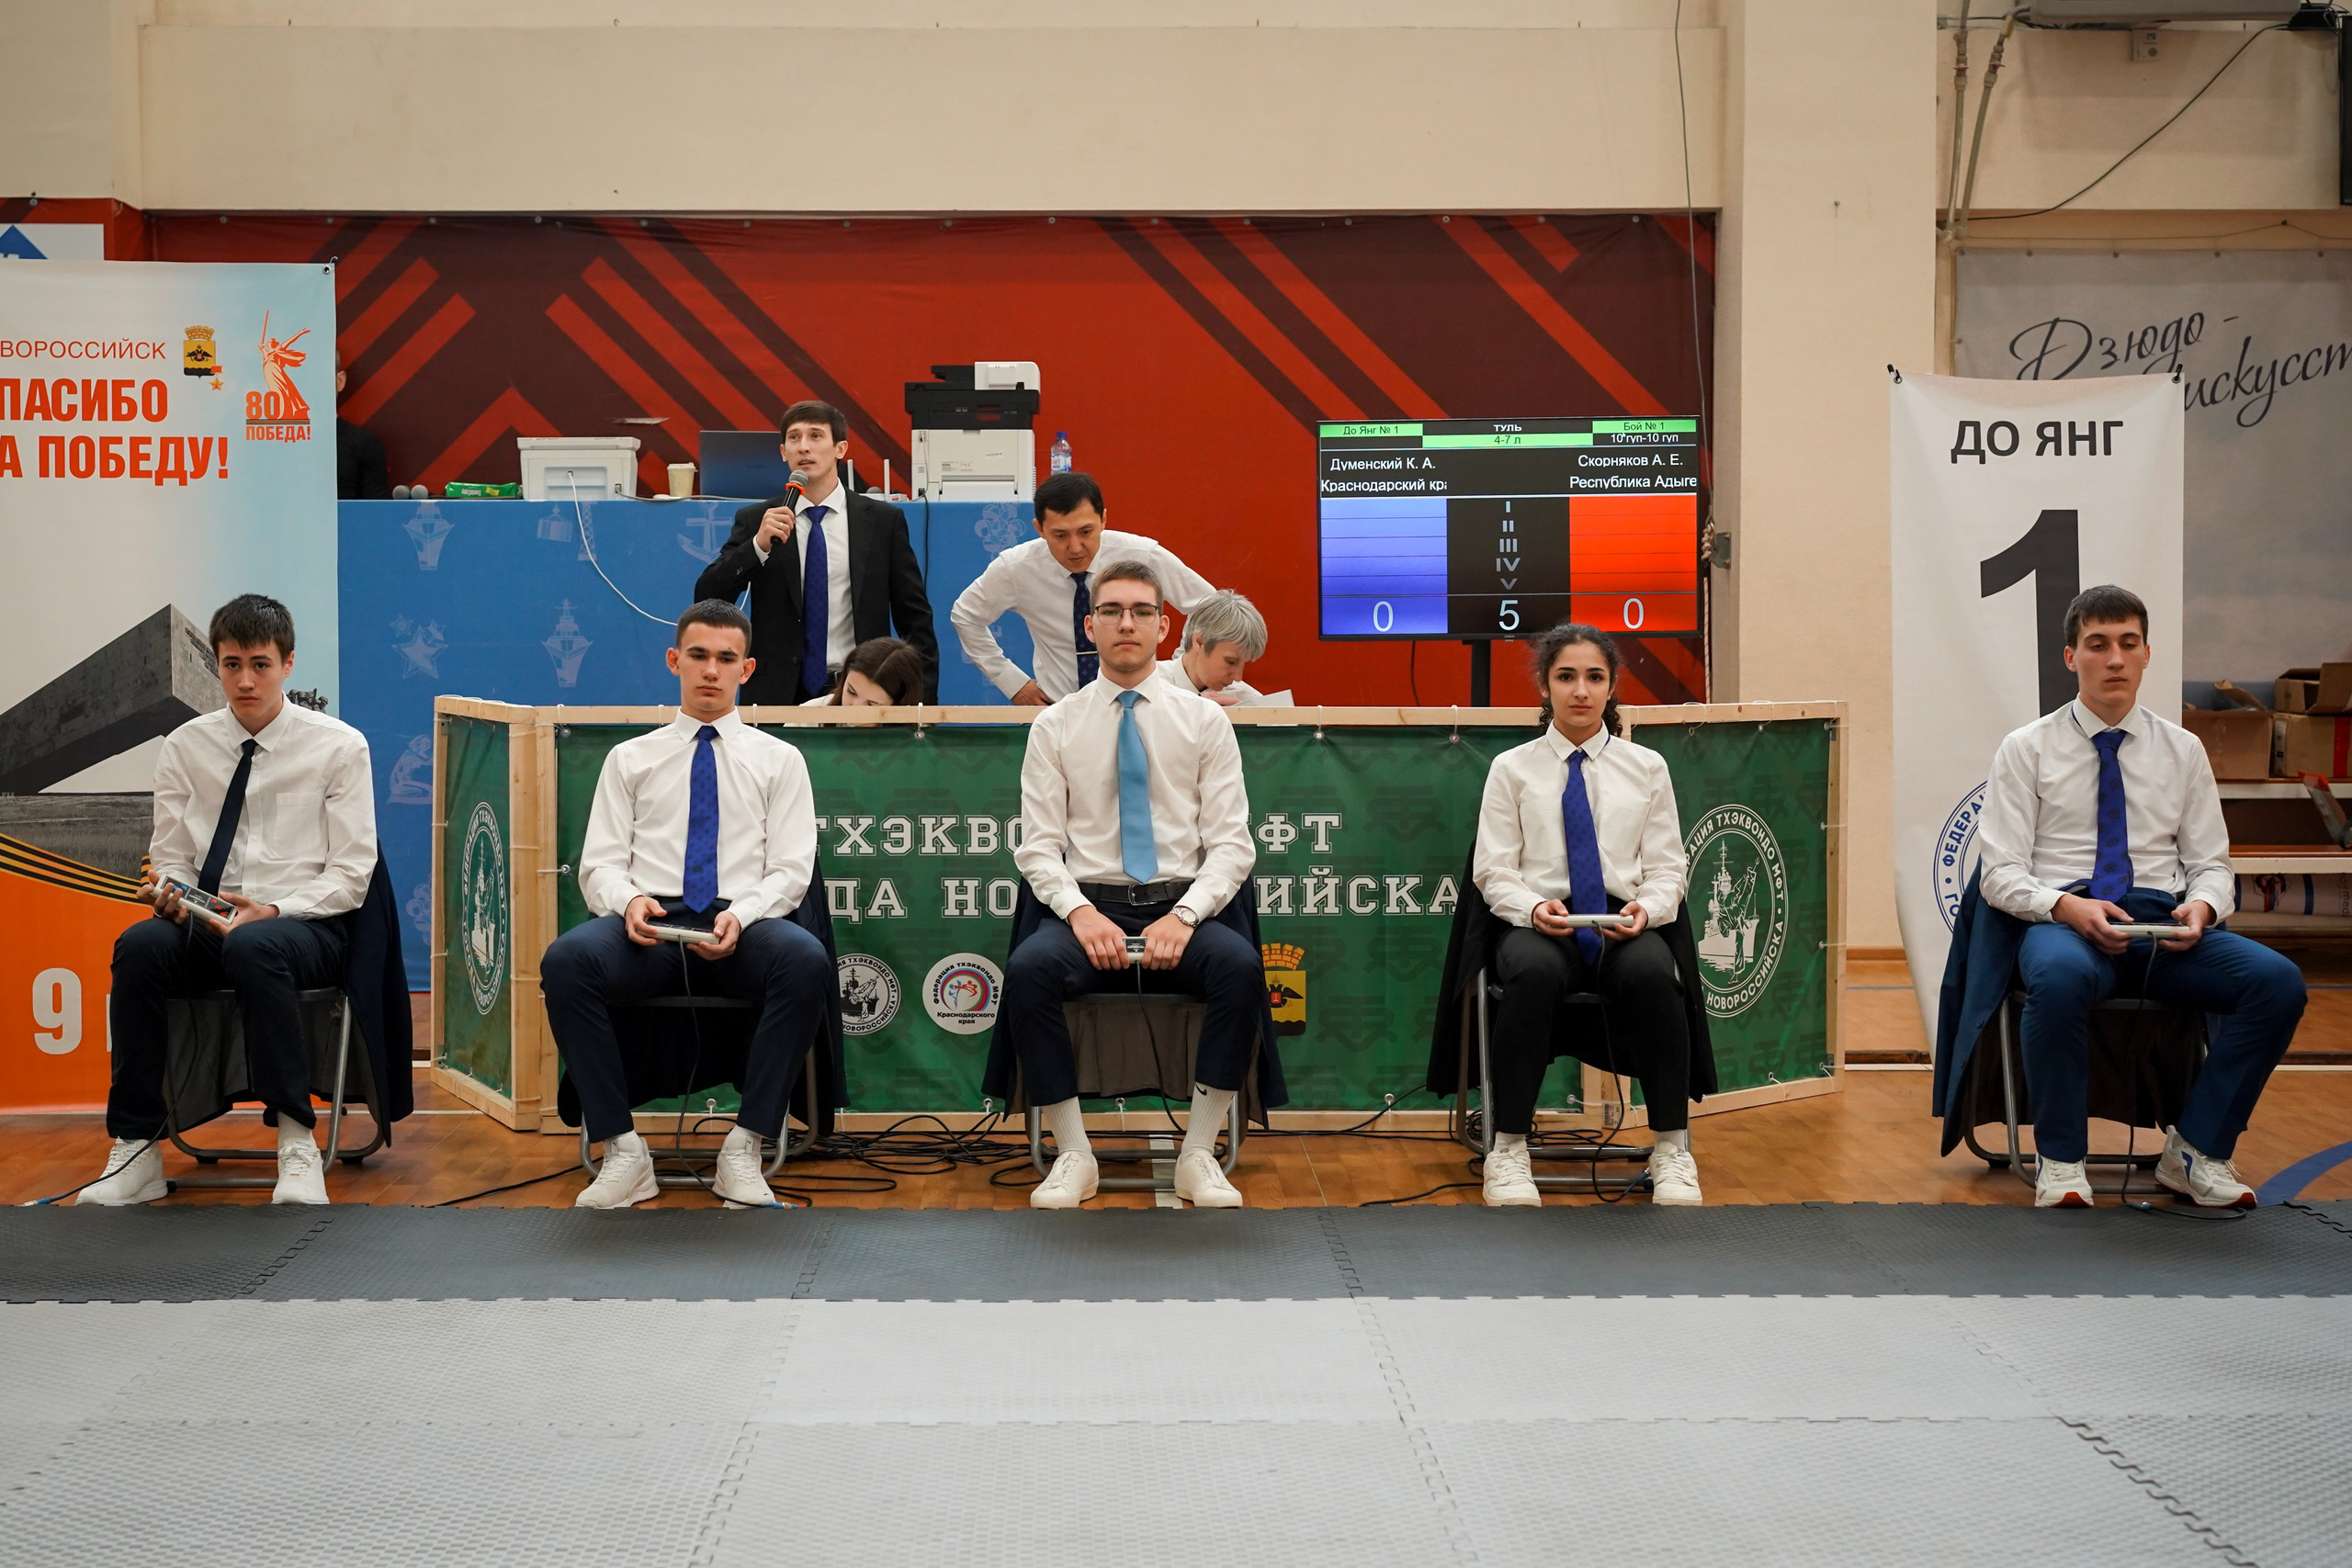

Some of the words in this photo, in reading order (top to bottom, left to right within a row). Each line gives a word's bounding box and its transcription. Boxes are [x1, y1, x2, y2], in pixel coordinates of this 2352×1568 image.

[0, 338, 166, 359] ВОРОССИЙСК
[0, 378, 168, 423] ПАСИБО
[245, 390, 281, 420] 80
[245, 425, 311, 443] ПОБЕДА!
[1343, 426, 1357, 435] До
[1359, 426, 1377, 435] Янг
[1379, 425, 1391, 434] №
[1393, 425, 1399, 434] 1
[1623, 422, 1643, 431] Бой
[1645, 422, 1657, 431] №
[1659, 422, 1665, 430] 1
[1494, 435, 1510, 445] 4-7
[1514, 436, 1521, 445] л
[1611, 434, 1623, 443] 10
[1662, 434, 1679, 444] гуп
[1951, 420, 2019, 465] ДО
[2035, 420, 2123, 457] ЯНГ
[39, 434, 229, 486] ПОБЕДУ!
[1330, 457, 1403, 471] Думенский
[1407, 458, 1419, 469] К.
[1422, 457, 1436, 469] А.
[1577, 455, 1648, 468] Скорняков
[1652, 455, 1666, 466] А.
[1670, 454, 1683, 466] Е.
[1321, 479, 1425, 492] Краснодарский
[1569, 475, 1650, 489] Республика
[1654, 475, 1697, 488] Адыге
[1502, 520, 1514, 532] II
[1499, 538, 1518, 552] III
[1496, 558, 1521, 571] IV
[1500, 578, 1518, 590] V
[1373, 601, 1395, 632] 0
[1498, 600, 1520, 631] 5
[1623, 597, 1645, 629] 0
[1980, 510, 2080, 718] 1
[1247, 813, 1341, 853] ФТ
[1942, 791, 1986, 867] ФЕДЕРА
[1686, 818, 1714, 871] РАЦИЯ
[1716, 811, 1775, 861] ТХЭКВОНДО
[1771, 863, 1784, 900] МФТ
[1706, 920, 1783, 1010] НОВОРОССИЙСКА
[32, 967, 82, 1055] 9
